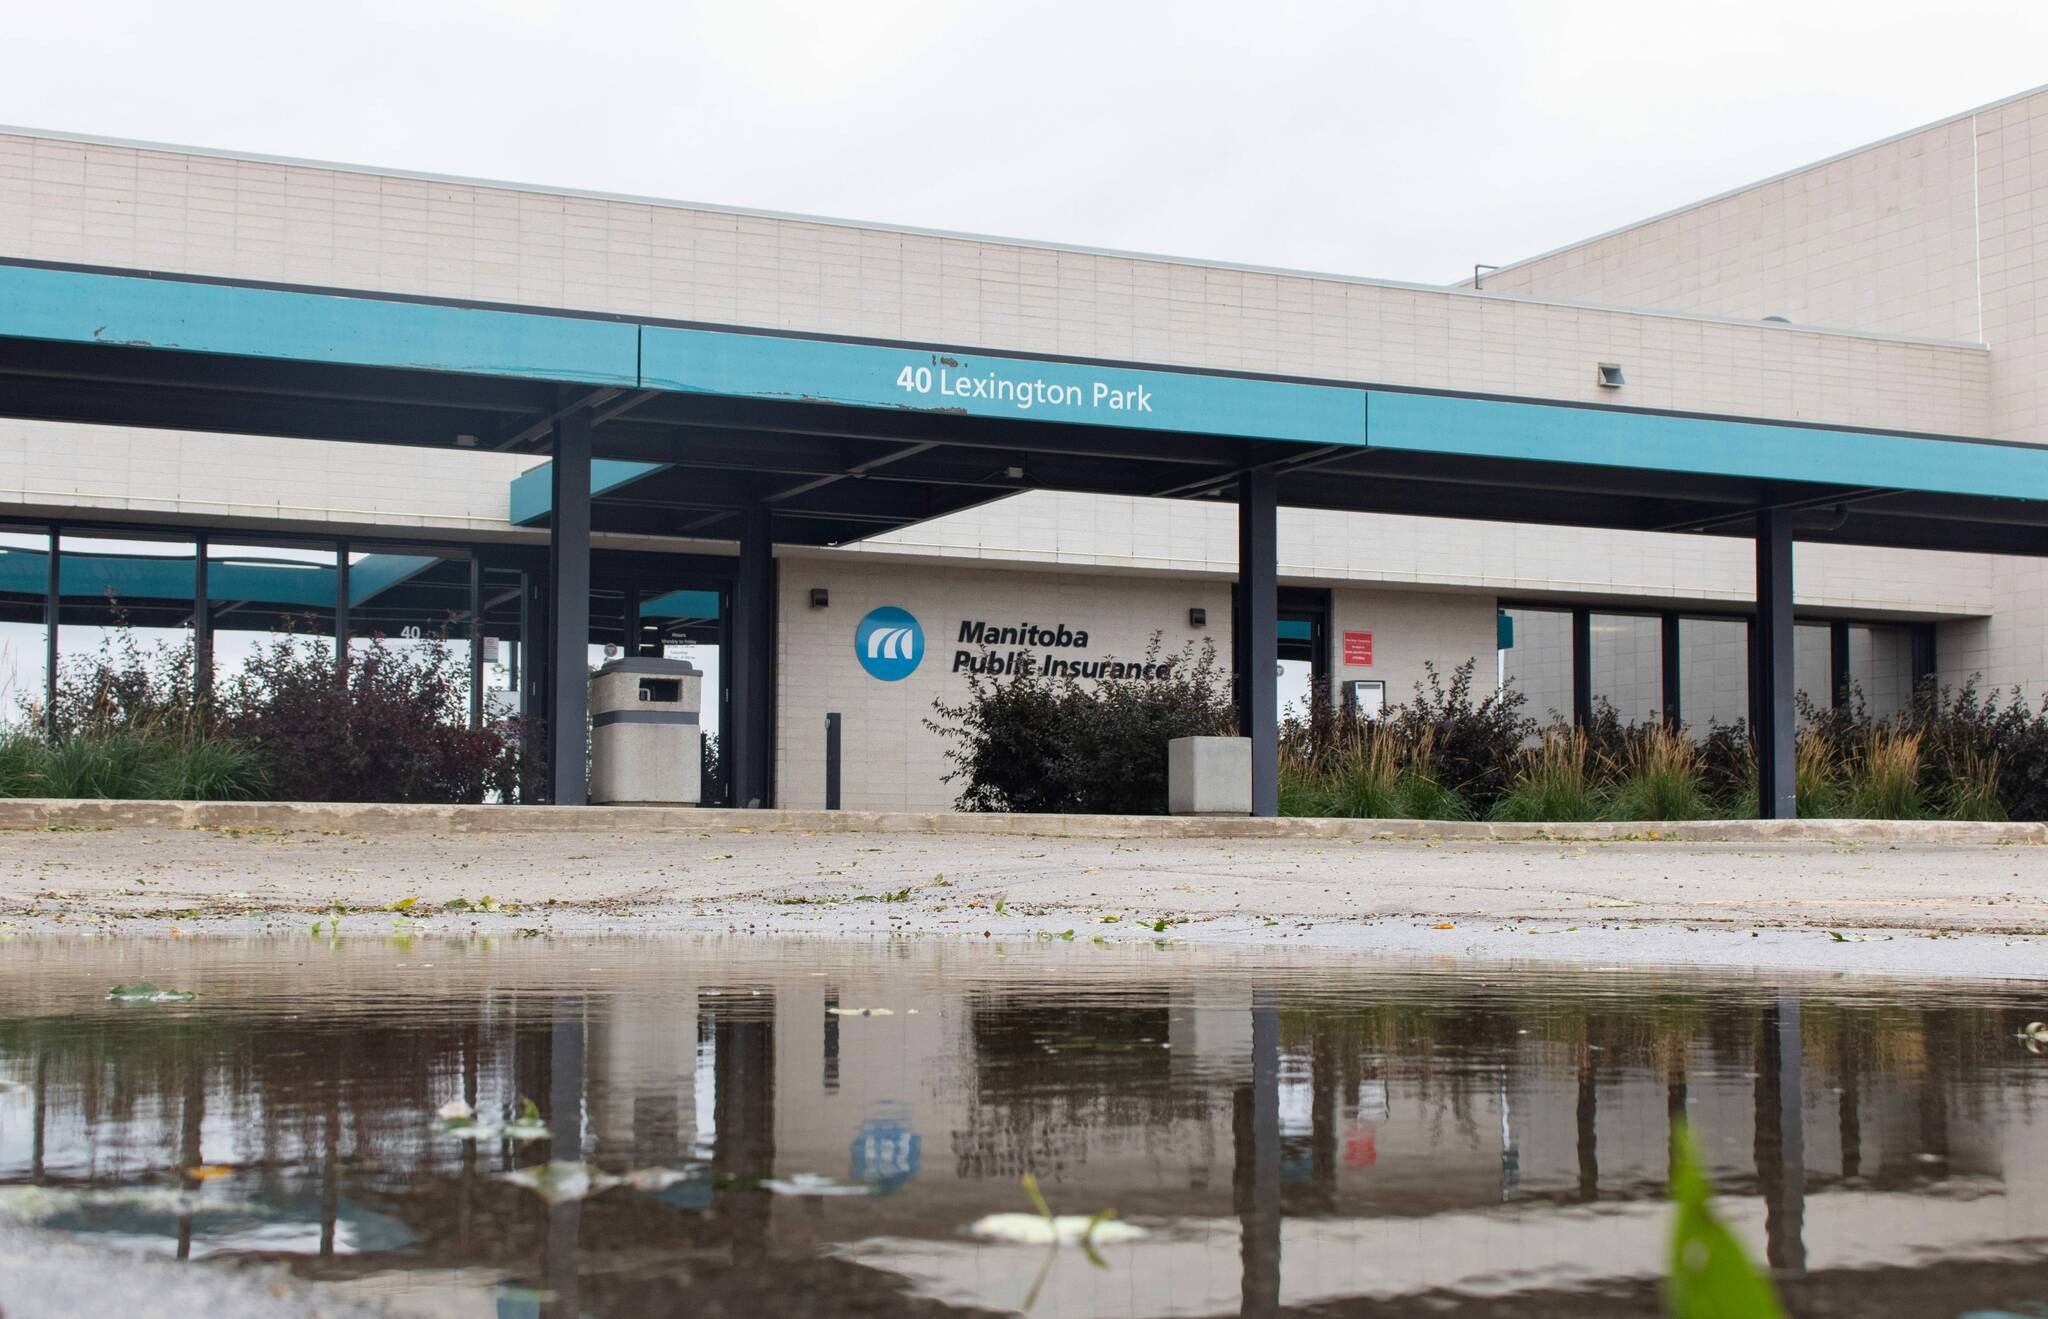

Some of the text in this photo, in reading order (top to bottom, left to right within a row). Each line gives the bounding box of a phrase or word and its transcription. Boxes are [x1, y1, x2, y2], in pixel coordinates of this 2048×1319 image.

[896, 366, 1152, 412] 40 Lexington Park
[401, 626, 421, 639] 40
[958, 620, 1088, 648] Manitoba
[1043, 655, 1170, 680] Insurance
